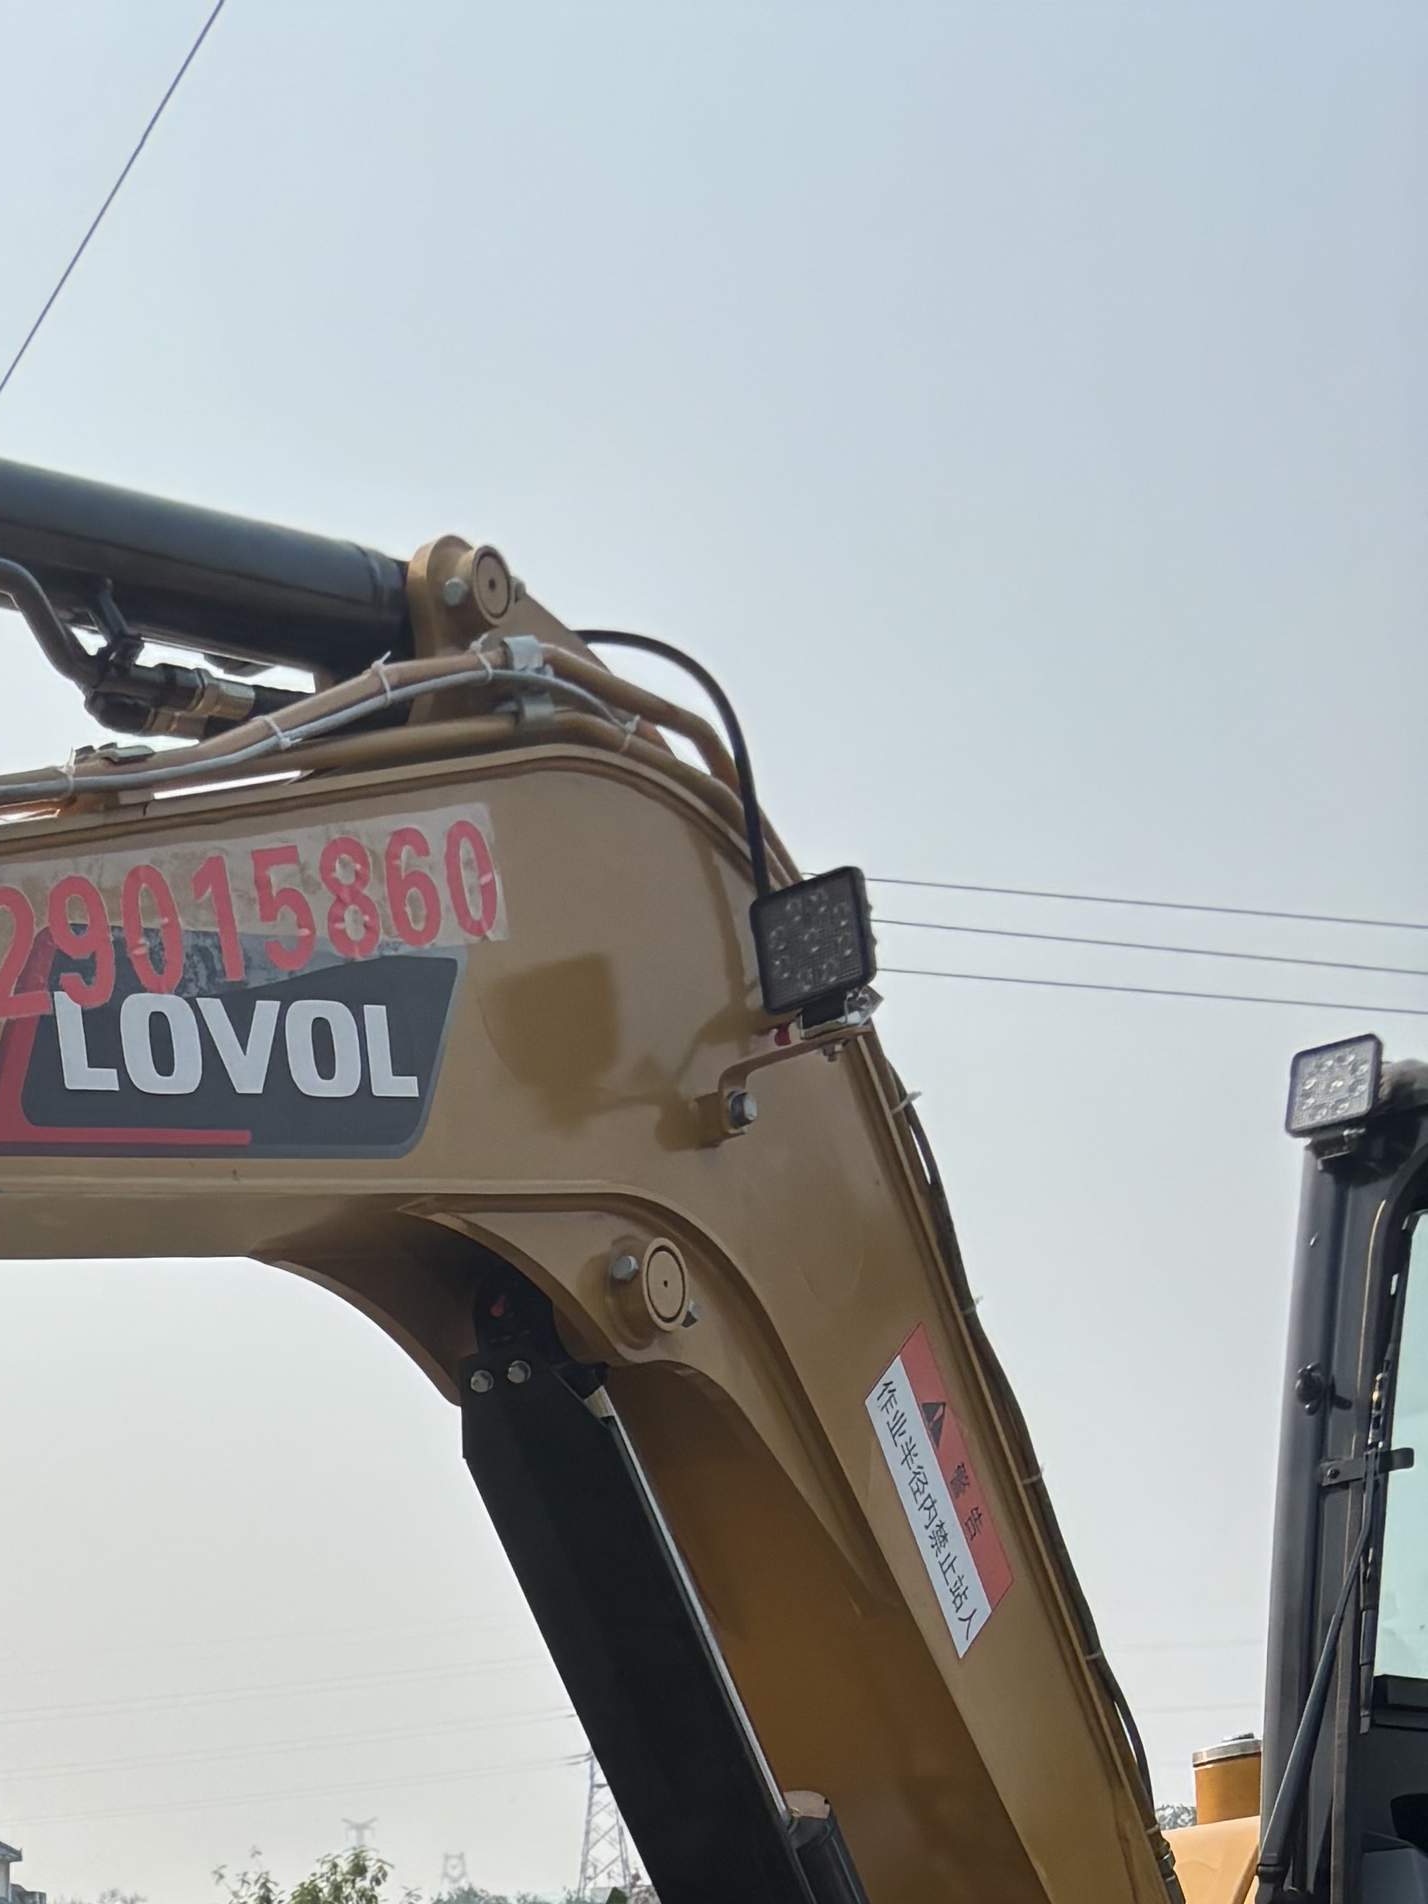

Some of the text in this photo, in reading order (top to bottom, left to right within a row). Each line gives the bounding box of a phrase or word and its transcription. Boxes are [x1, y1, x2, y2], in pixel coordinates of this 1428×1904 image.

[53, 991, 419, 1098] LOVOL
[875, 1380, 979, 1641] 作业半径内禁止站人
[949, 1461, 985, 1543] 警告
